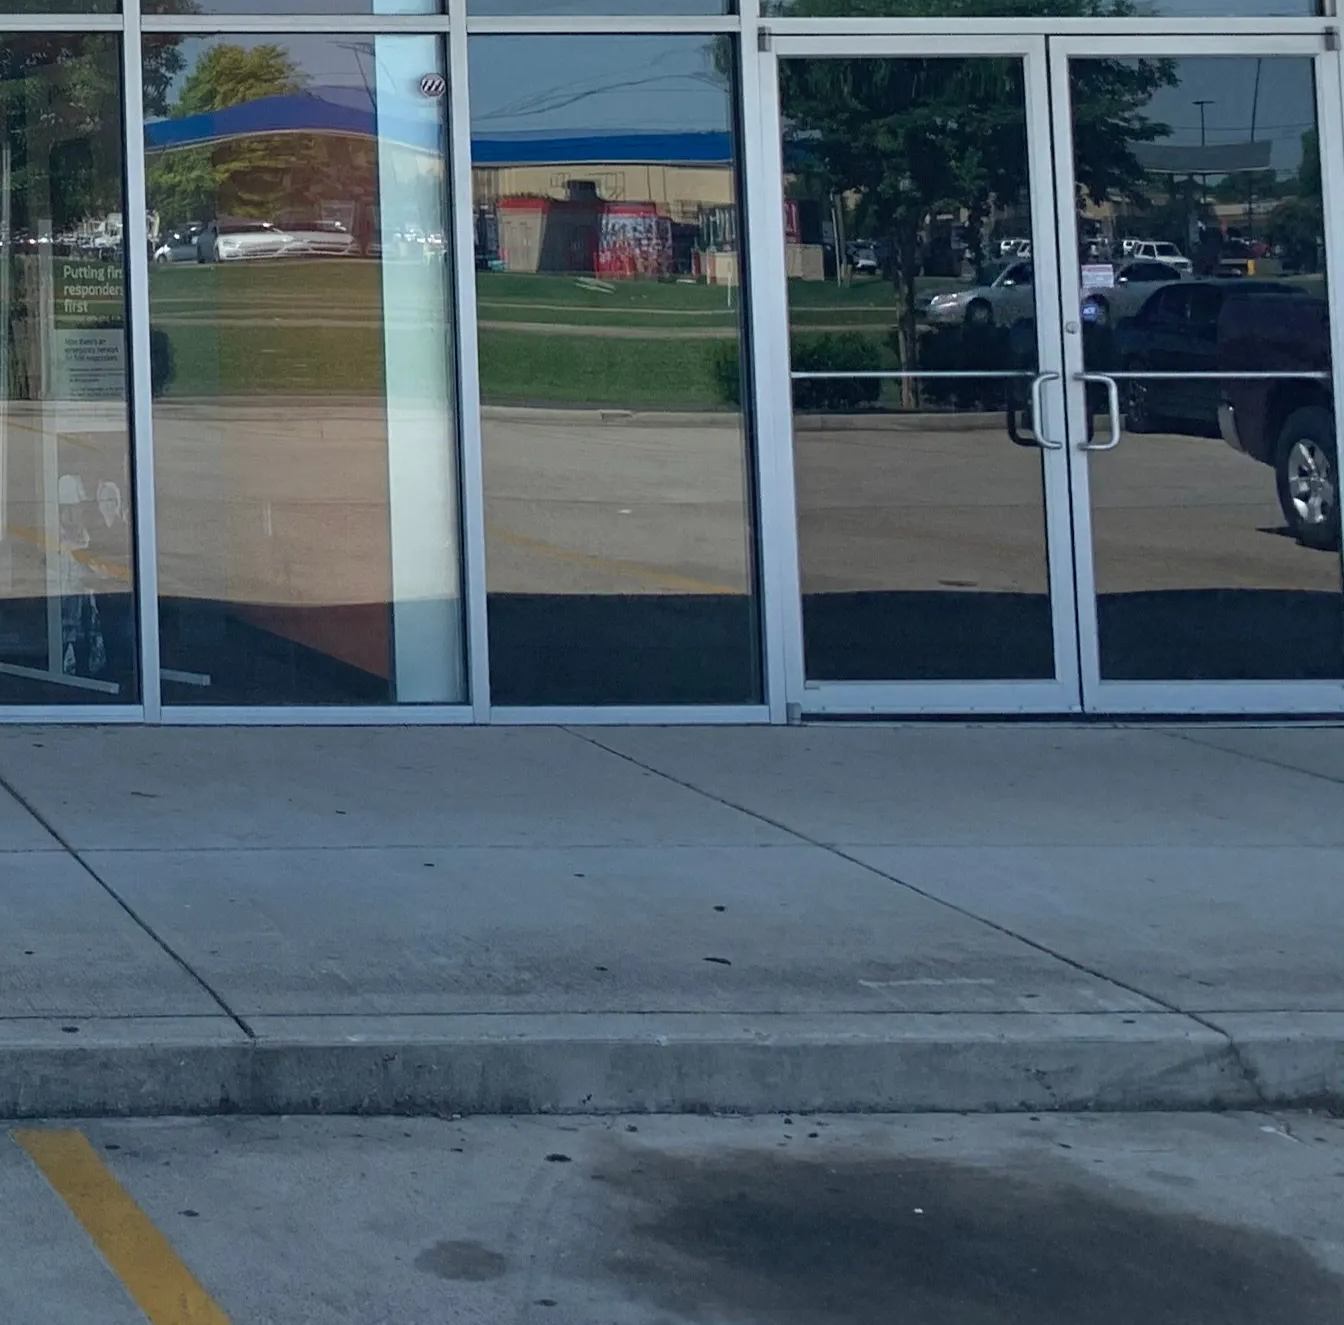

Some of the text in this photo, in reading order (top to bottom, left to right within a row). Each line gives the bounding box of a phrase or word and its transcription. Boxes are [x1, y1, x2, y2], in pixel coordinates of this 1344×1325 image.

[63, 265, 123, 280] Putting fir
[64, 299, 89, 313] first
